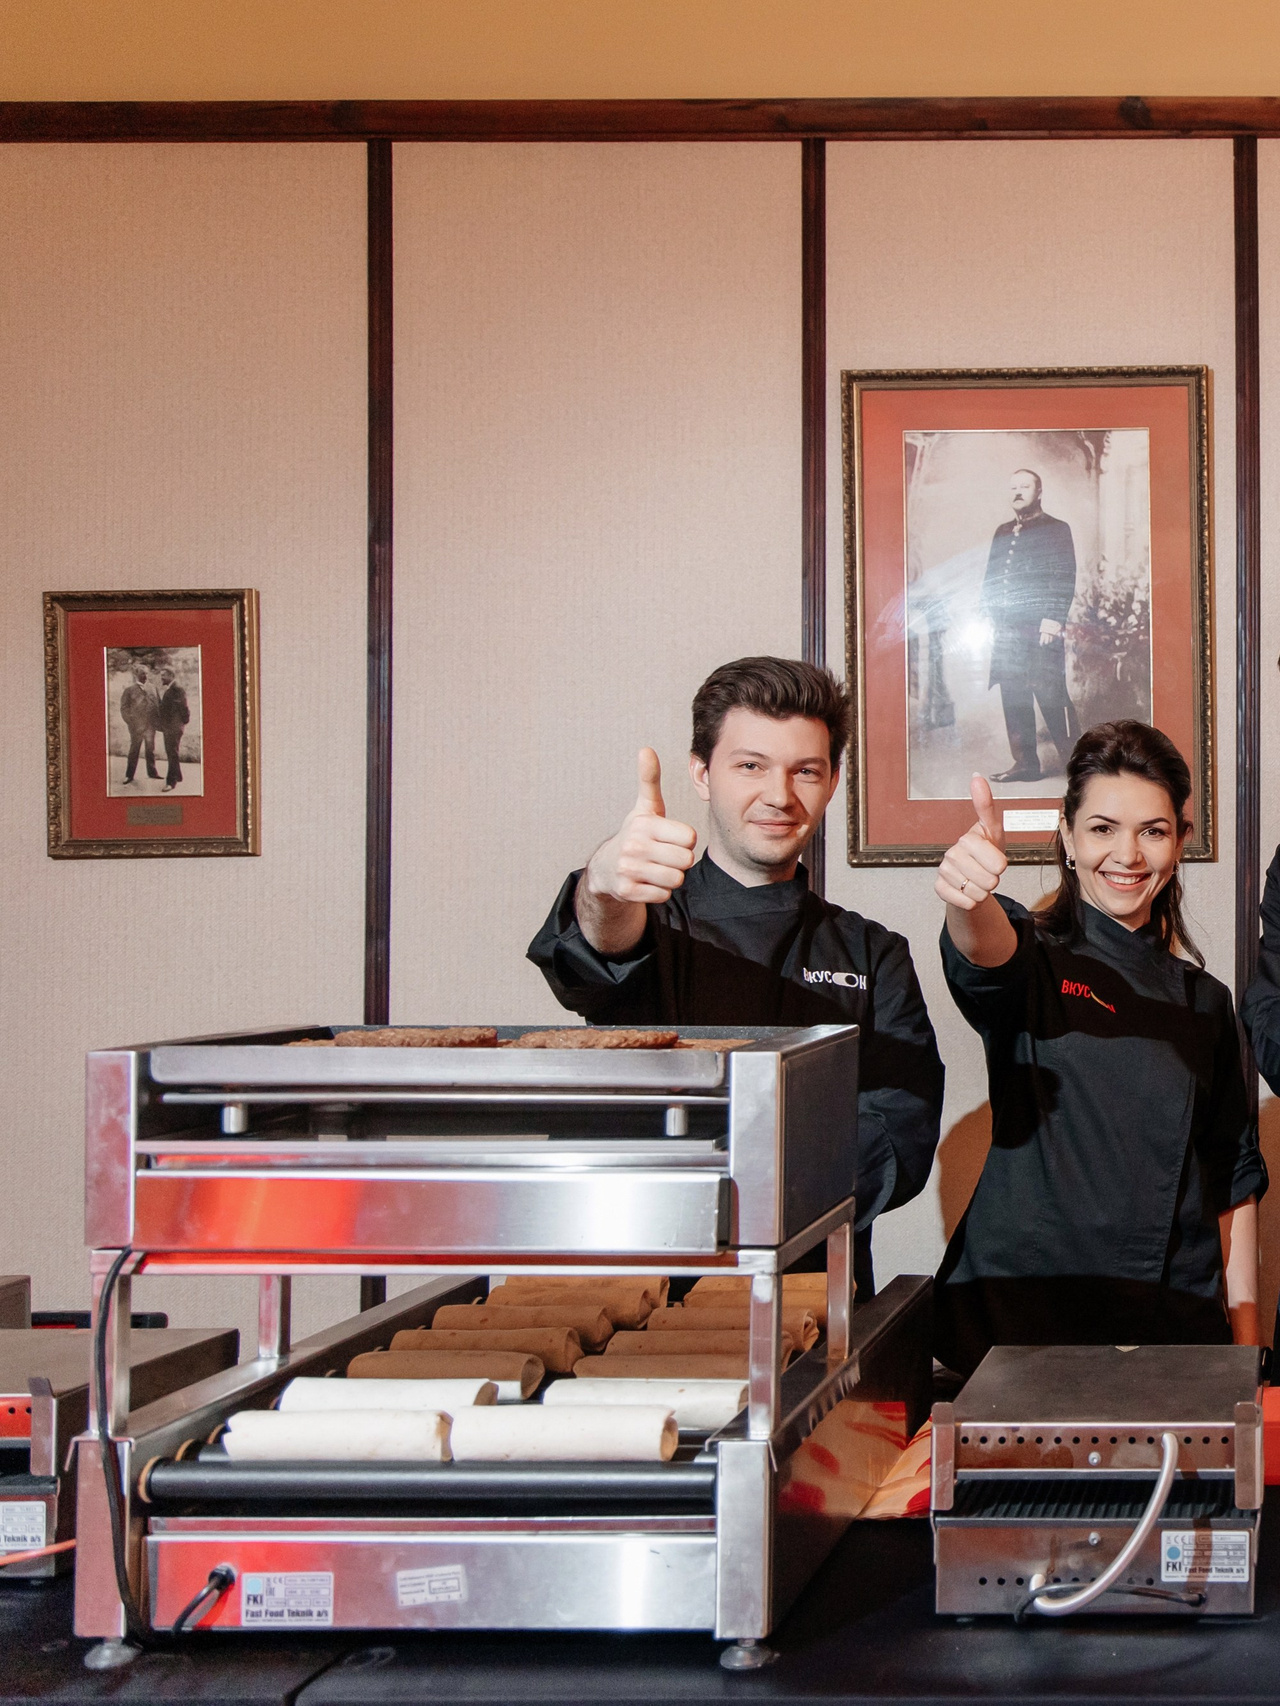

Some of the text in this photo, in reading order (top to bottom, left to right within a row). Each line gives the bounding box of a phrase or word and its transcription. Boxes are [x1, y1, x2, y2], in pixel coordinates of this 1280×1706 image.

[3, 1535, 41, 1543] Teknik a/s
[1166, 1561, 1182, 1572] FKI
[1184, 1566, 1197, 1574] Fast
[1198, 1566, 1212, 1574] Food
[1214, 1566, 1234, 1574] Teknik
[246, 1594, 264, 1606] FKI
[245, 1609, 329, 1618] Fast Food Teknik a/s
